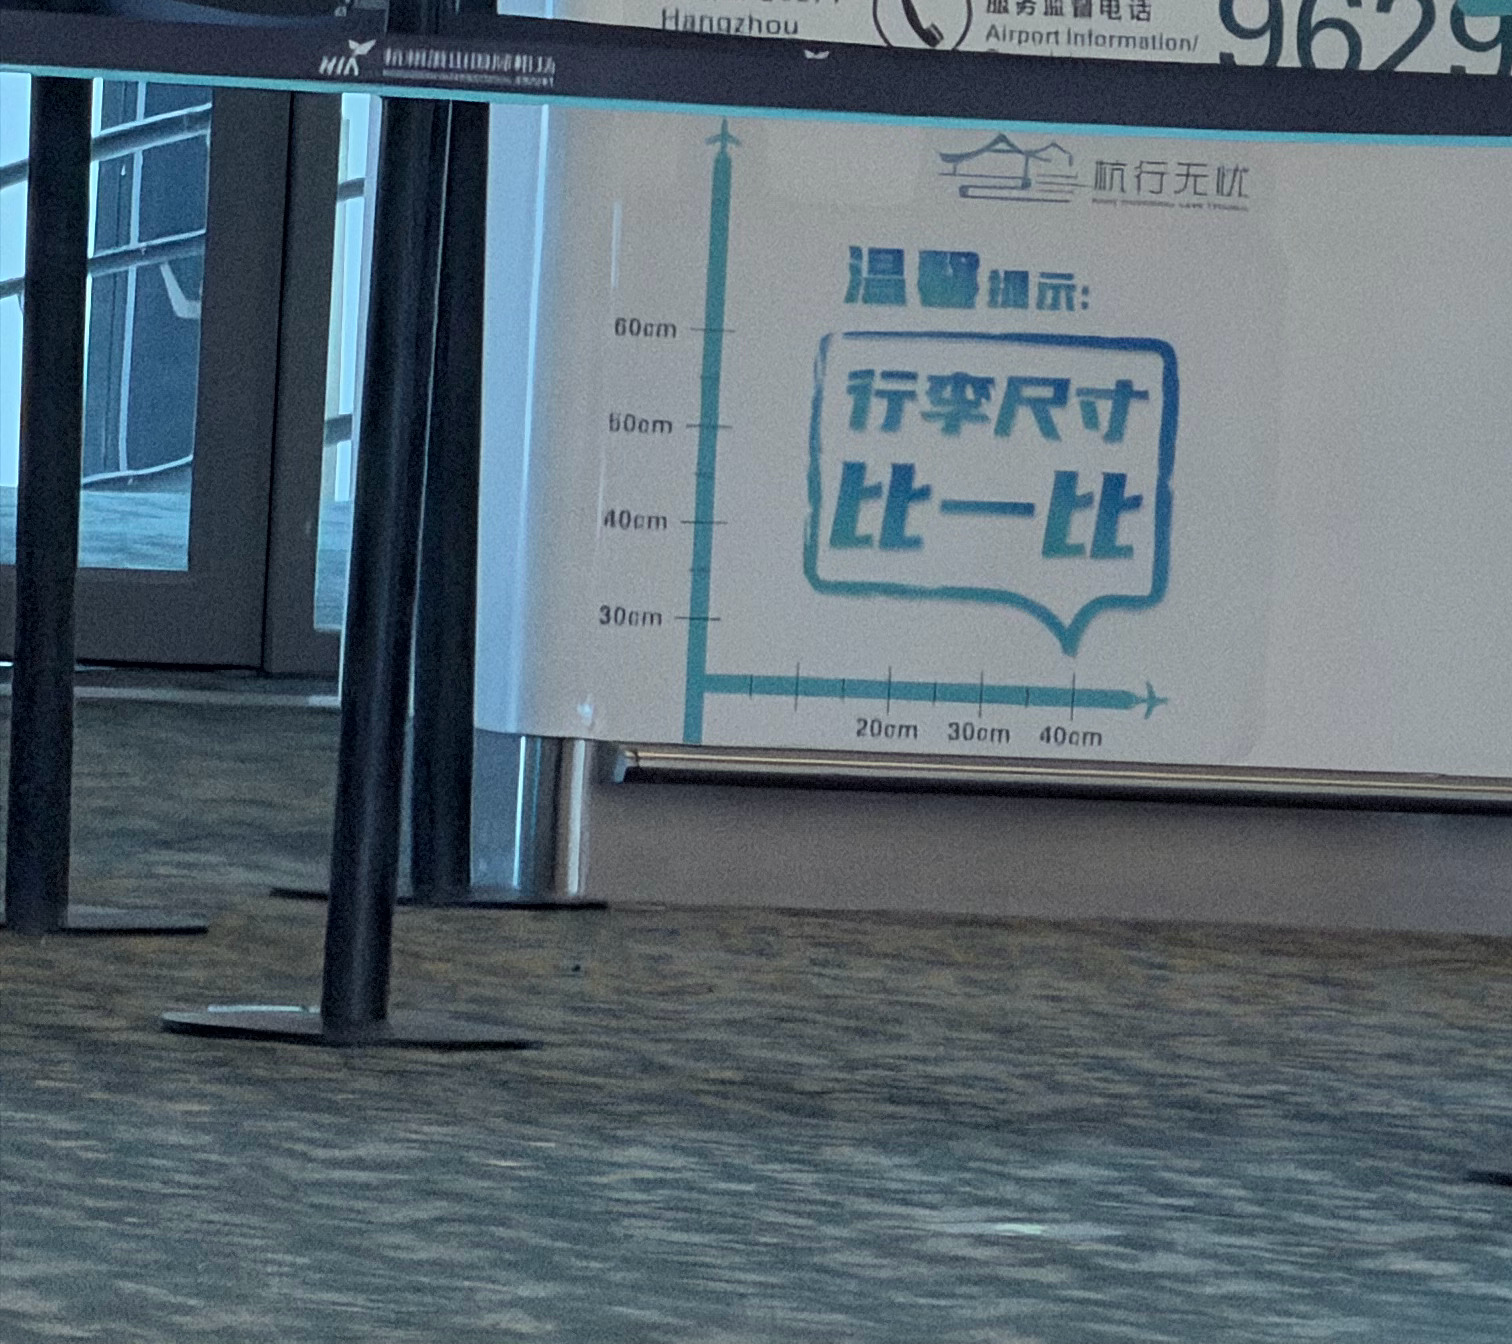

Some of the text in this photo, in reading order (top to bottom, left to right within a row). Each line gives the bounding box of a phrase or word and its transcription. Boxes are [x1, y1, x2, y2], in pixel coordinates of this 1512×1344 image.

[662, 8, 799, 37] Hangzhou
[985, 23, 1060, 47] Airport
[1093, 160, 1250, 199] 杭行无忧
[614, 317, 677, 341] 60cm
[846, 368, 1150, 444] 行李尺寸
[608, 413, 673, 437] 50cm
[603, 509, 668, 533] 40cm
[829, 459, 1144, 560] 比一比
[598, 605, 663, 629] 30cm
[856, 718, 1103, 749] 20cm 30cm 40cm
